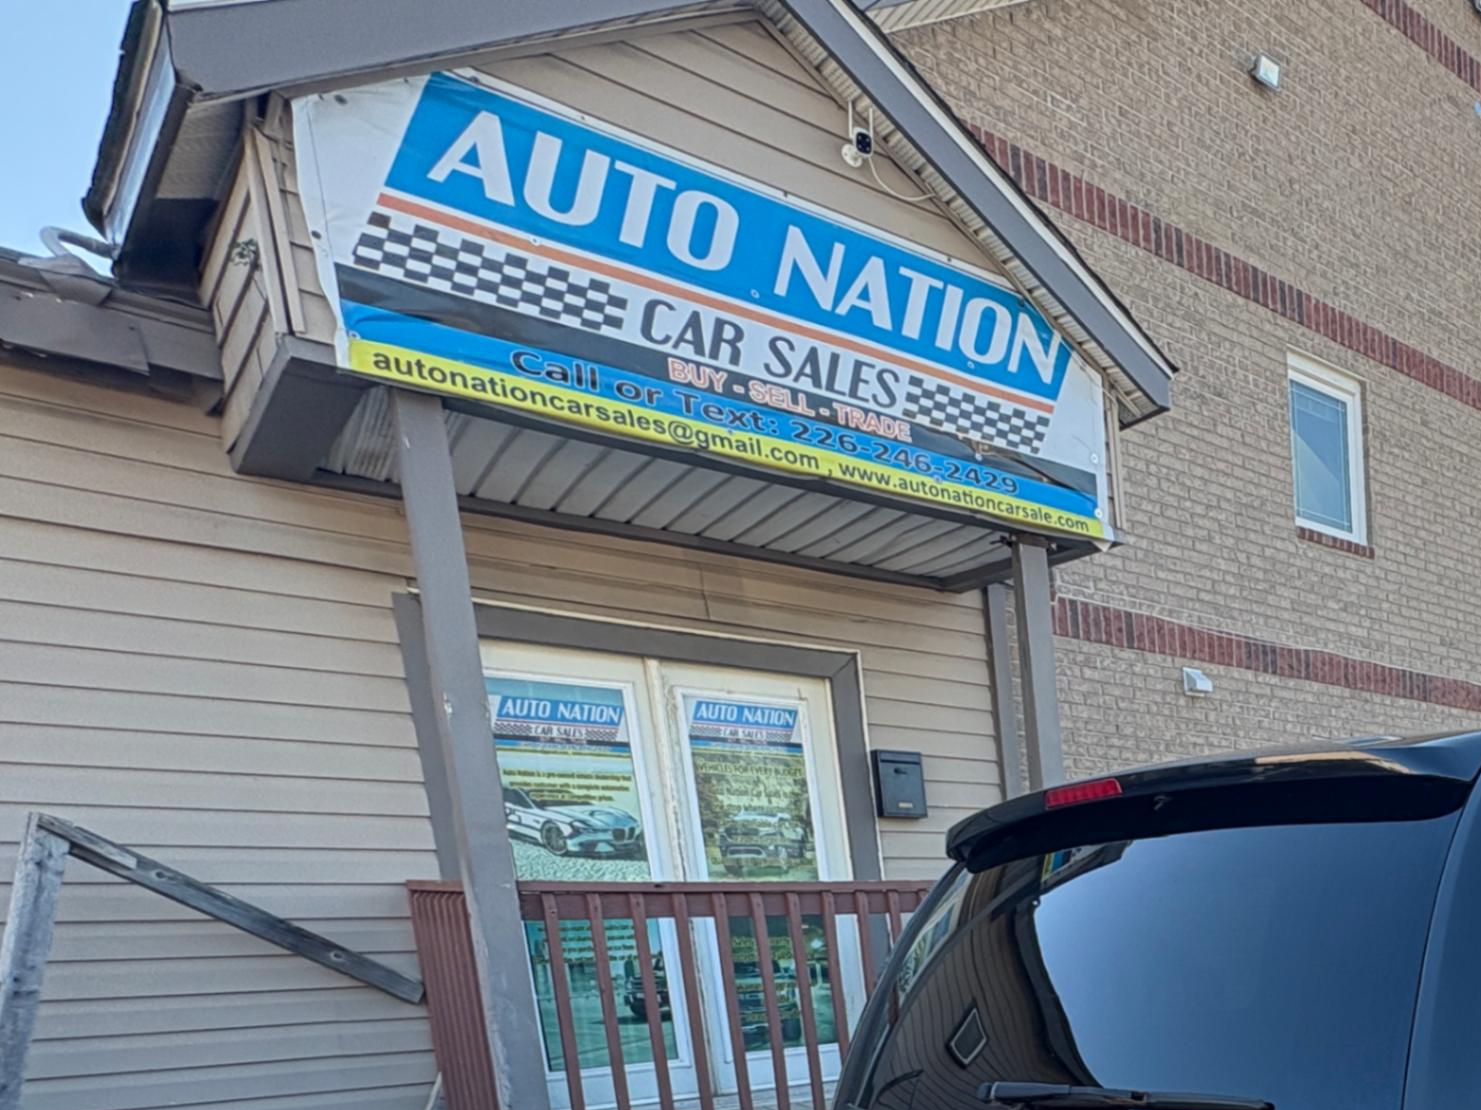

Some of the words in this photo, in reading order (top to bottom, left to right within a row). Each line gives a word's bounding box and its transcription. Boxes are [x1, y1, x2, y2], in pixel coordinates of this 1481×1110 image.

[427, 110, 740, 272] AUTO
[773, 225, 1061, 384] NATION
[640, 298, 745, 367] CAR
[763, 336, 900, 408] SALES
[667, 357, 727, 394] BUY
[749, 380, 815, 417] SELL
[832, 401, 913, 443] TRADE
[373, 352, 819, 471] autonationcarsales@gmail.com
[511, 350, 600, 391] Call
[615, 381, 661, 404] or
[674, 388, 779, 434] Text:
[791, 421, 1019, 494] 226-246-2429
[502, 698, 550, 717] AUTO
[557, 702, 620, 723] NATION
[696, 703, 738, 720] AUTO
[742, 708, 795, 726] NATION
